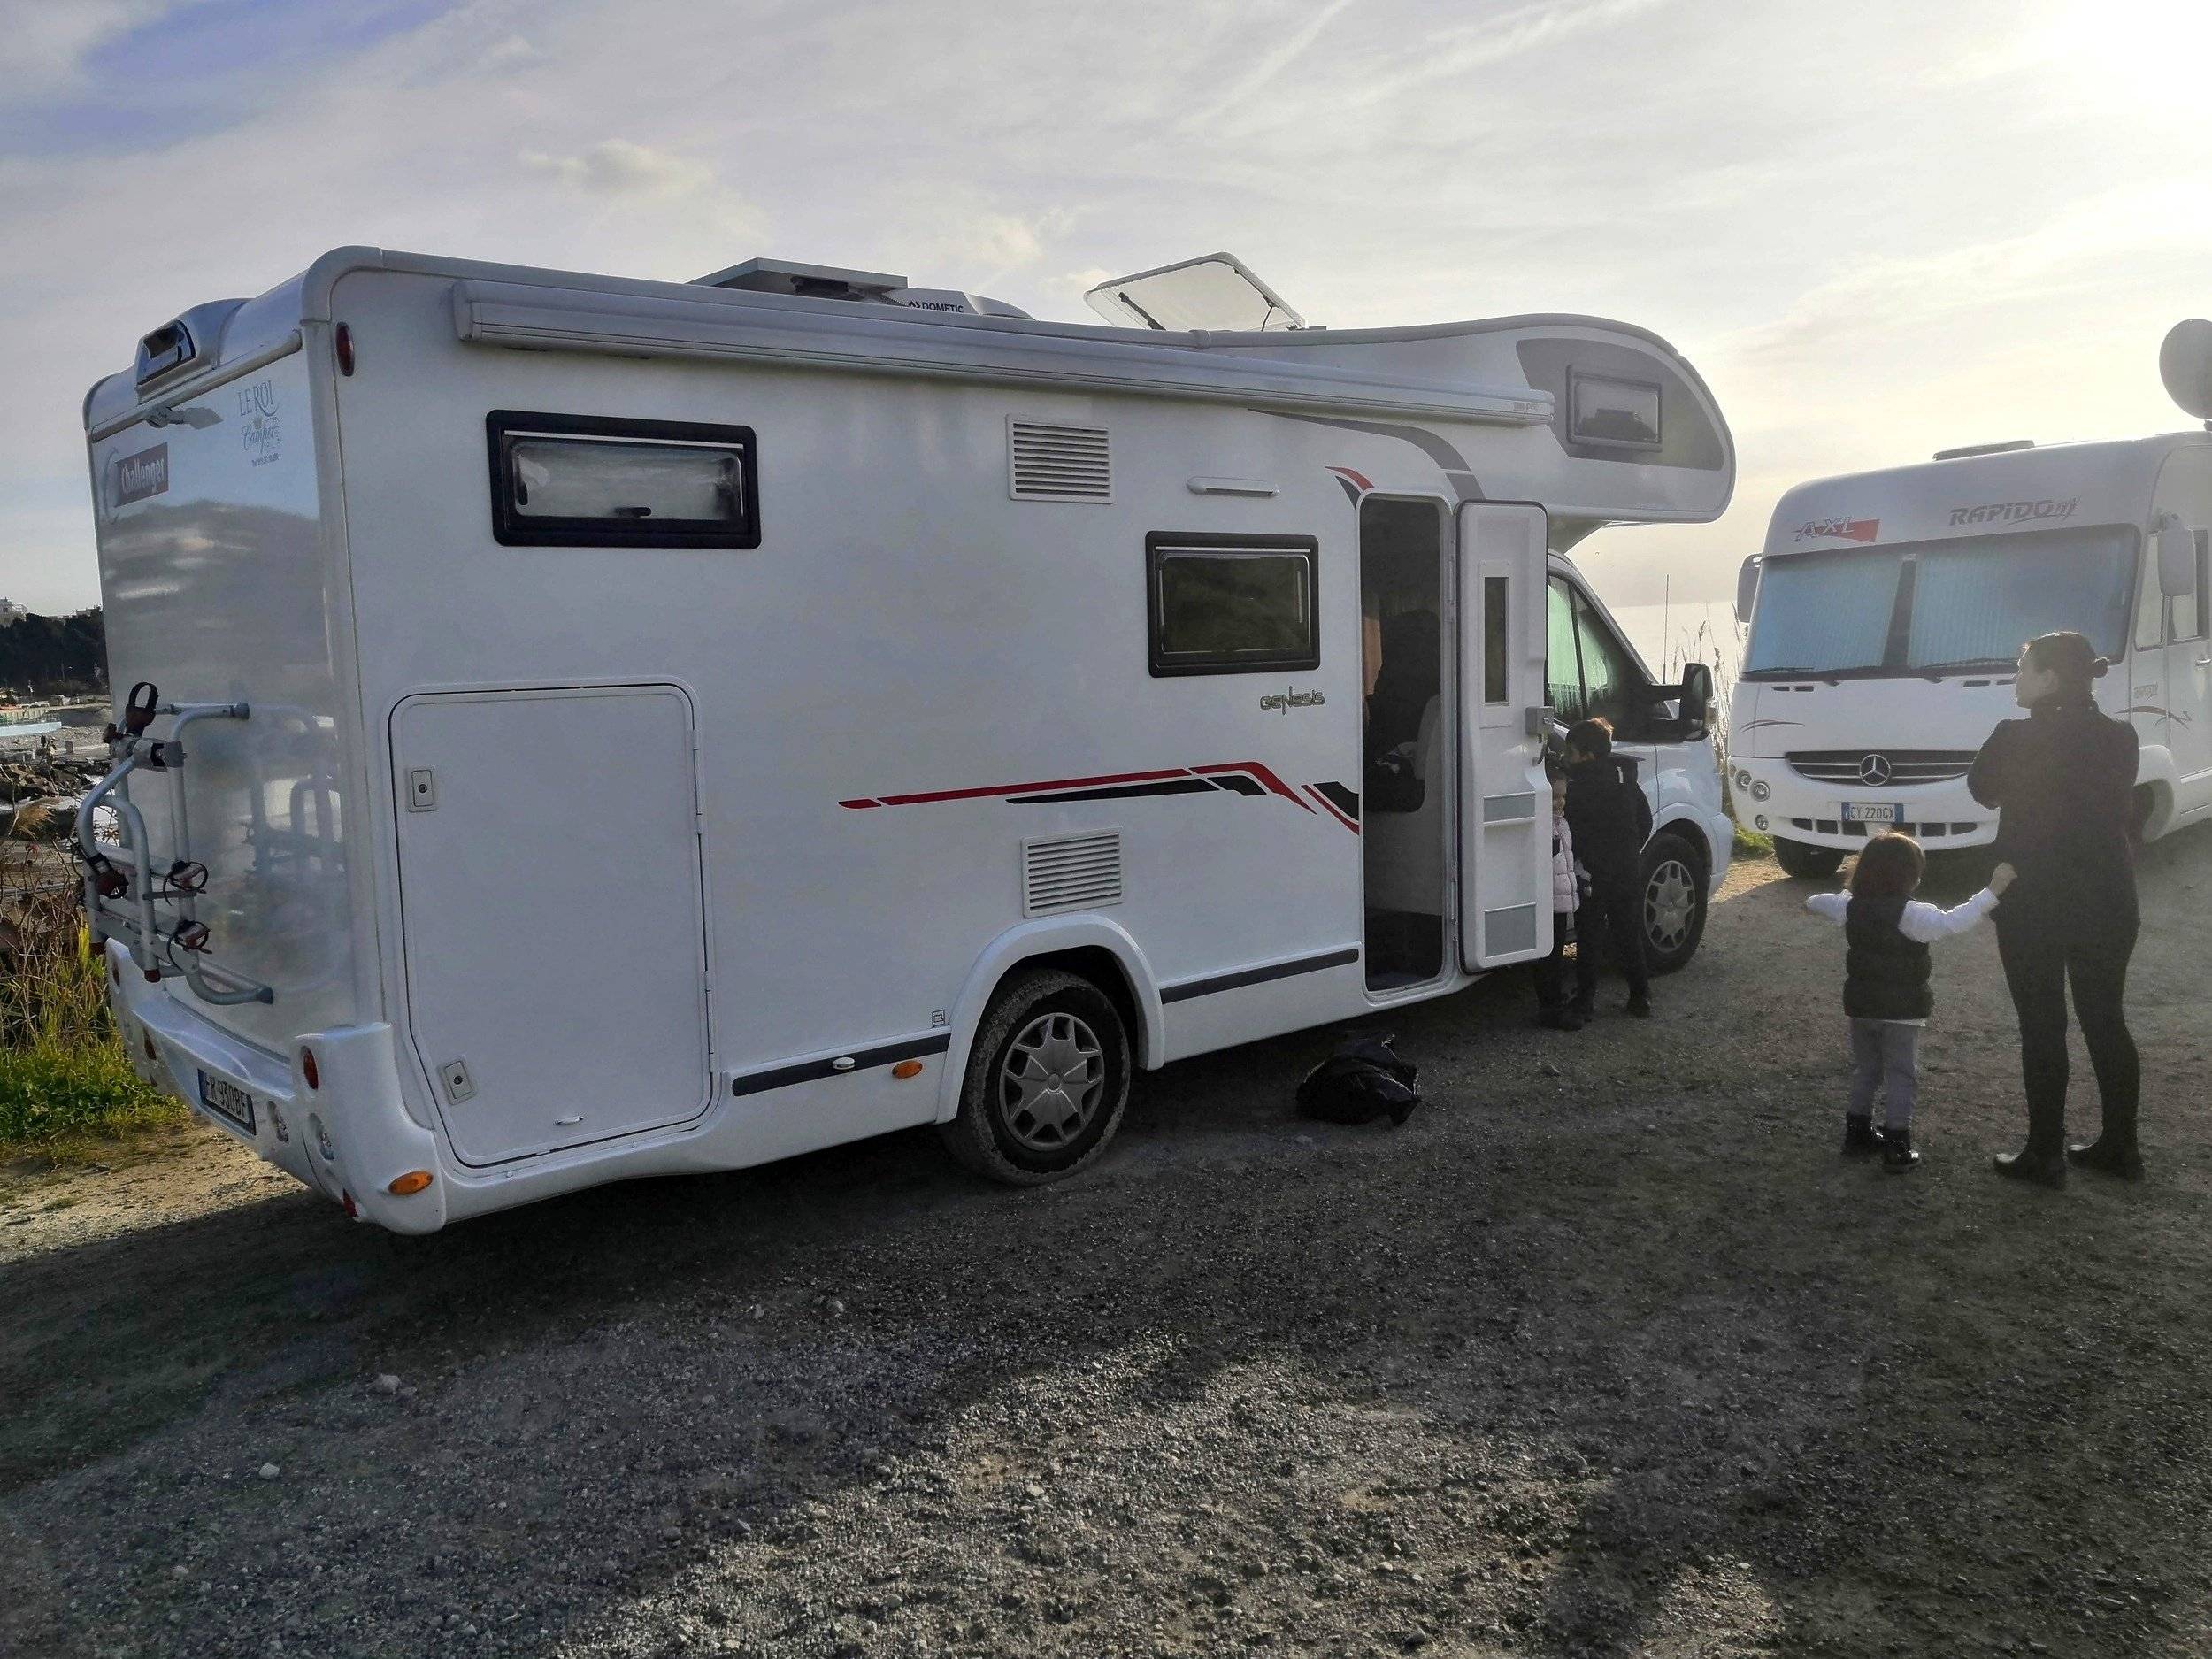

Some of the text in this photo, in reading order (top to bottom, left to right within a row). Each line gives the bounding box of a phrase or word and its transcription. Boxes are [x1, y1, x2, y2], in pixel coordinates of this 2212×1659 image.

[922, 302, 964, 313] DOMETIC
[121, 458, 165, 495] Challenger
[1794, 517, 1854, 541] AXL
